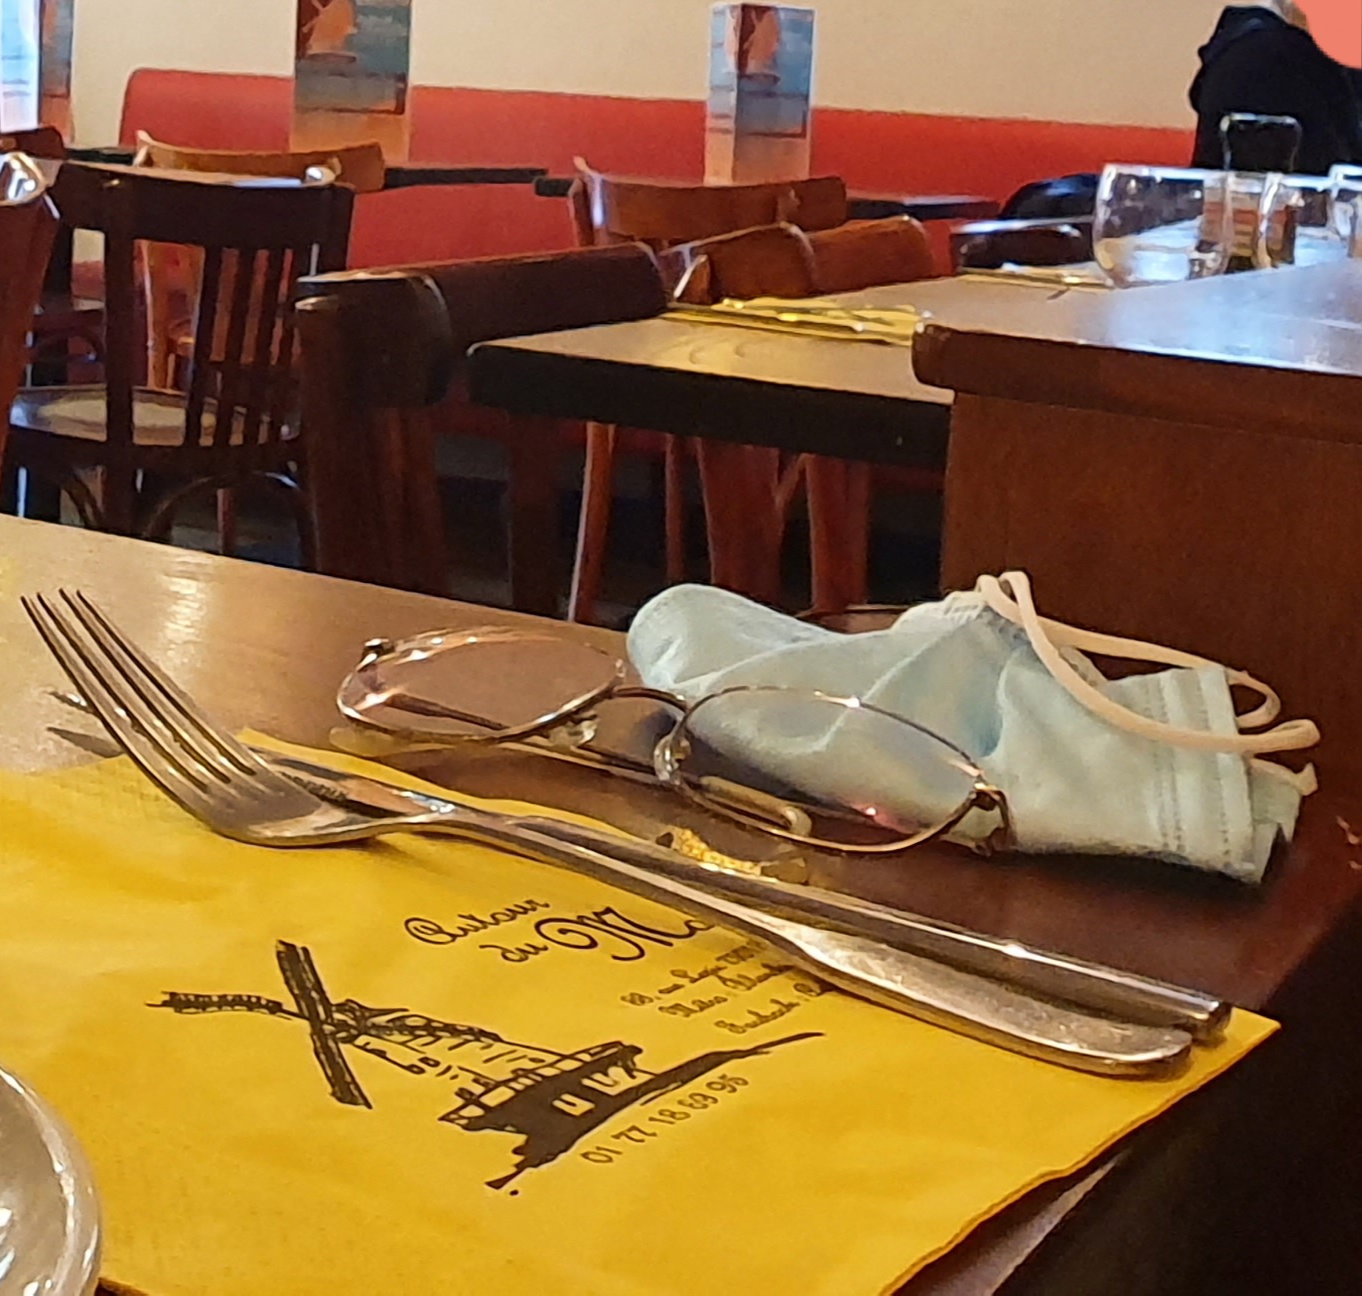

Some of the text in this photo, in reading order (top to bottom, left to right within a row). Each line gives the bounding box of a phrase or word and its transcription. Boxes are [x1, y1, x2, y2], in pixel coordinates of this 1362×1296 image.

[580, 1145, 623, 1164] 01
[611, 1124, 658, 1143] 77
[648, 1108, 692, 1125] 18
[705, 1074, 750, 1094] 95
